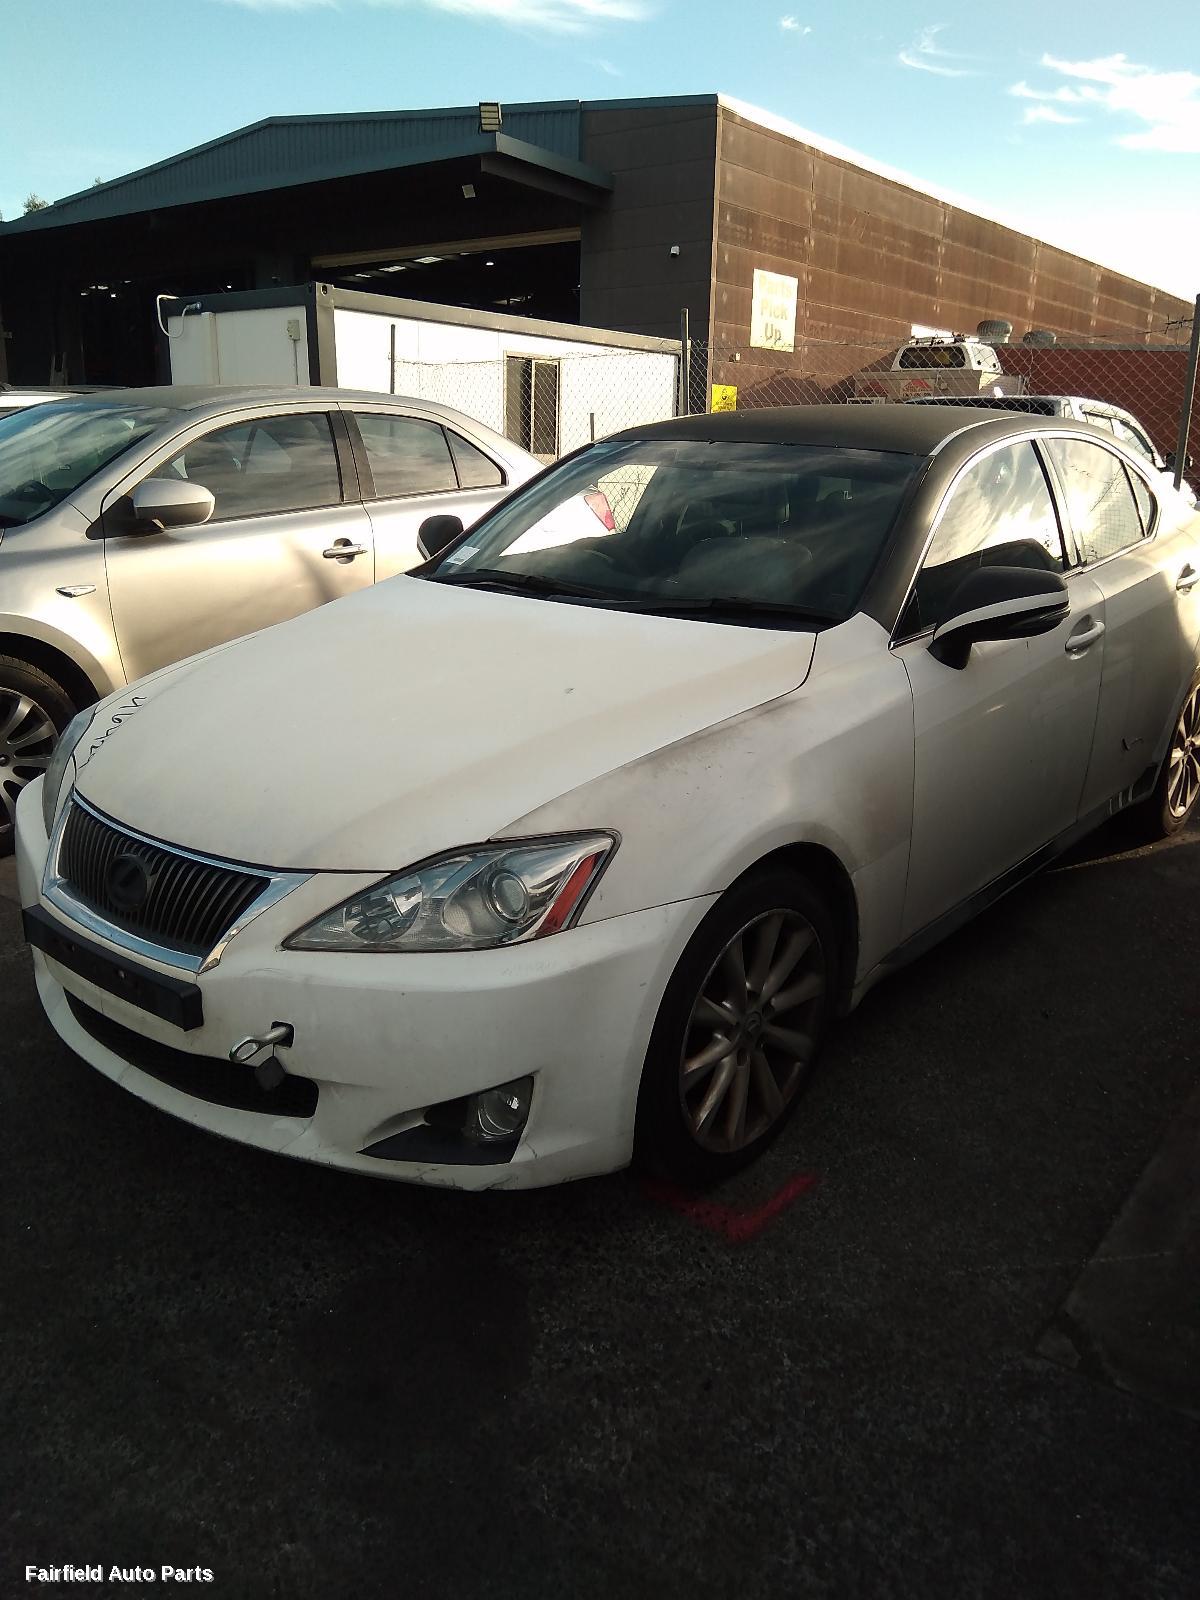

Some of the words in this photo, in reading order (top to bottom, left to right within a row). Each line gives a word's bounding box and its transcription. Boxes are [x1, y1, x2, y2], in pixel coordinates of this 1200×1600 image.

[758, 274, 792, 297] Parts
[760, 299, 788, 321] Pick
[764, 322, 782, 346] Up
